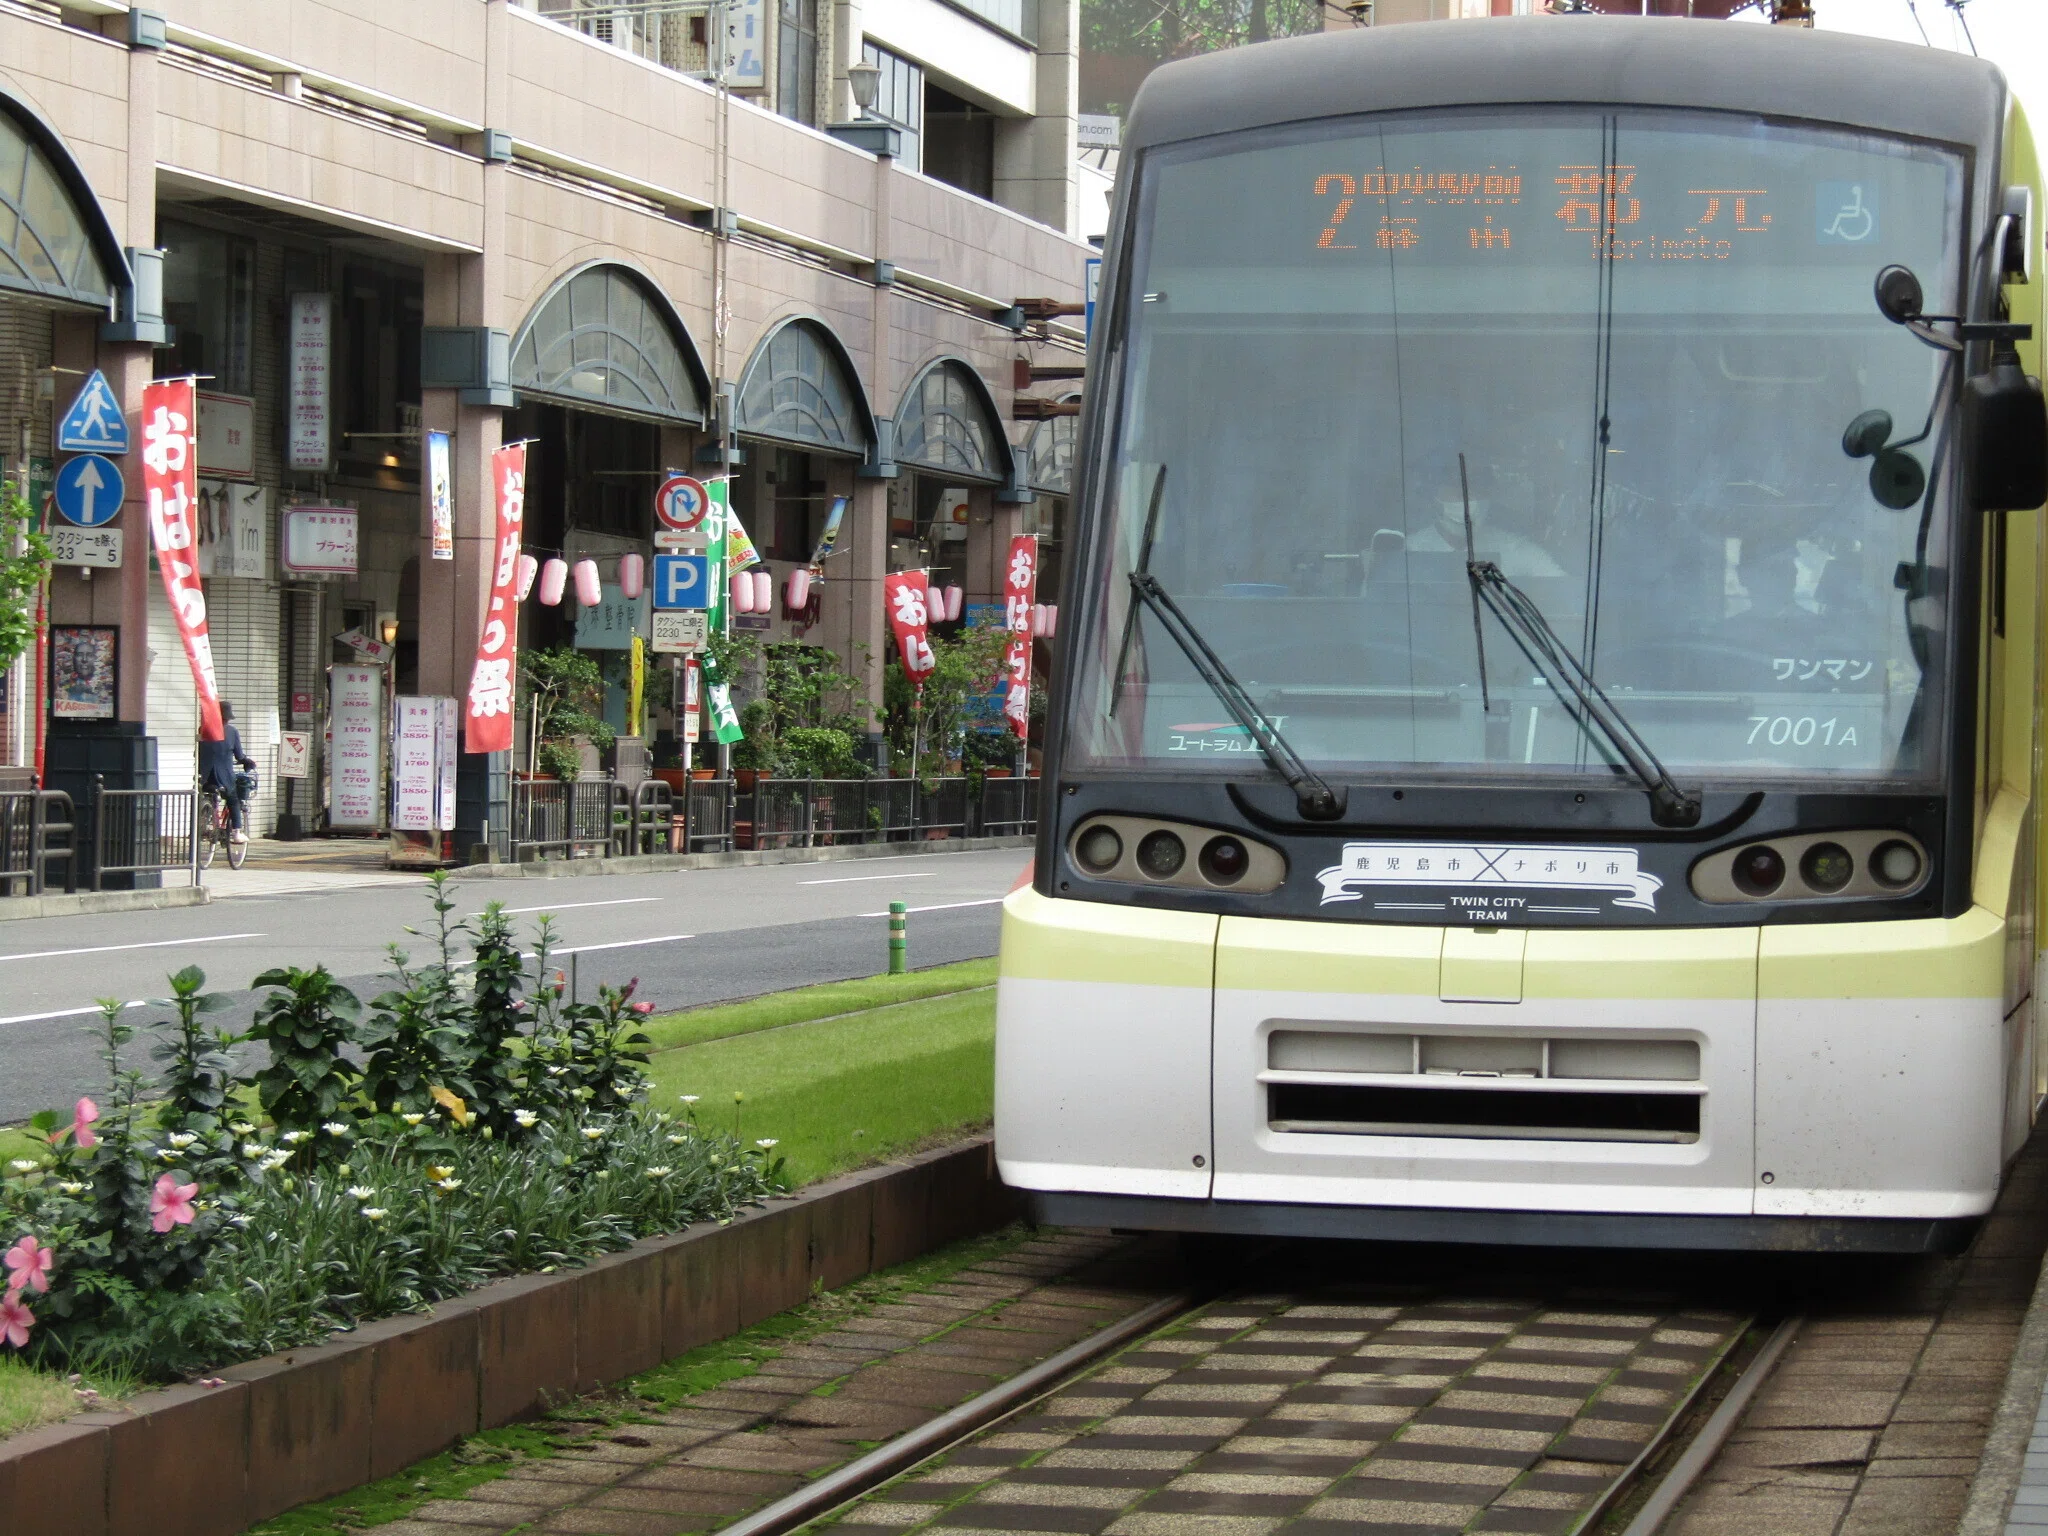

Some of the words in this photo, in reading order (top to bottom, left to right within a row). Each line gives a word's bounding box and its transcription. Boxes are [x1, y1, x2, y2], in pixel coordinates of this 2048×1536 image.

[1554, 165, 1772, 233] 郡元
[1314, 173, 1356, 249] 2
[1591, 235, 1731, 259] Korimoto
[56, 531, 117, 548] タクシーを除く
[56, 546, 75, 560] 23
[107, 549, 117, 562] 5
[668, 560, 699, 603] P
[656, 627, 680, 638] 2230
[696, 628, 703, 639] 6
[1772, 658, 1873, 681] ワンマン
[344, 726, 372, 734] 1760
[1747, 716, 1858, 747] 7001A
[1168, 735, 1242, 752] ユートラム
[1357, 857, 1461, 871] 鹿児島市
[1513, 859, 1620, 875] ナポリ市
[1450, 896, 1489, 907] TWIN
[1493, 897, 1527, 908] CITY
[1466, 910, 1508, 921] TRAM
